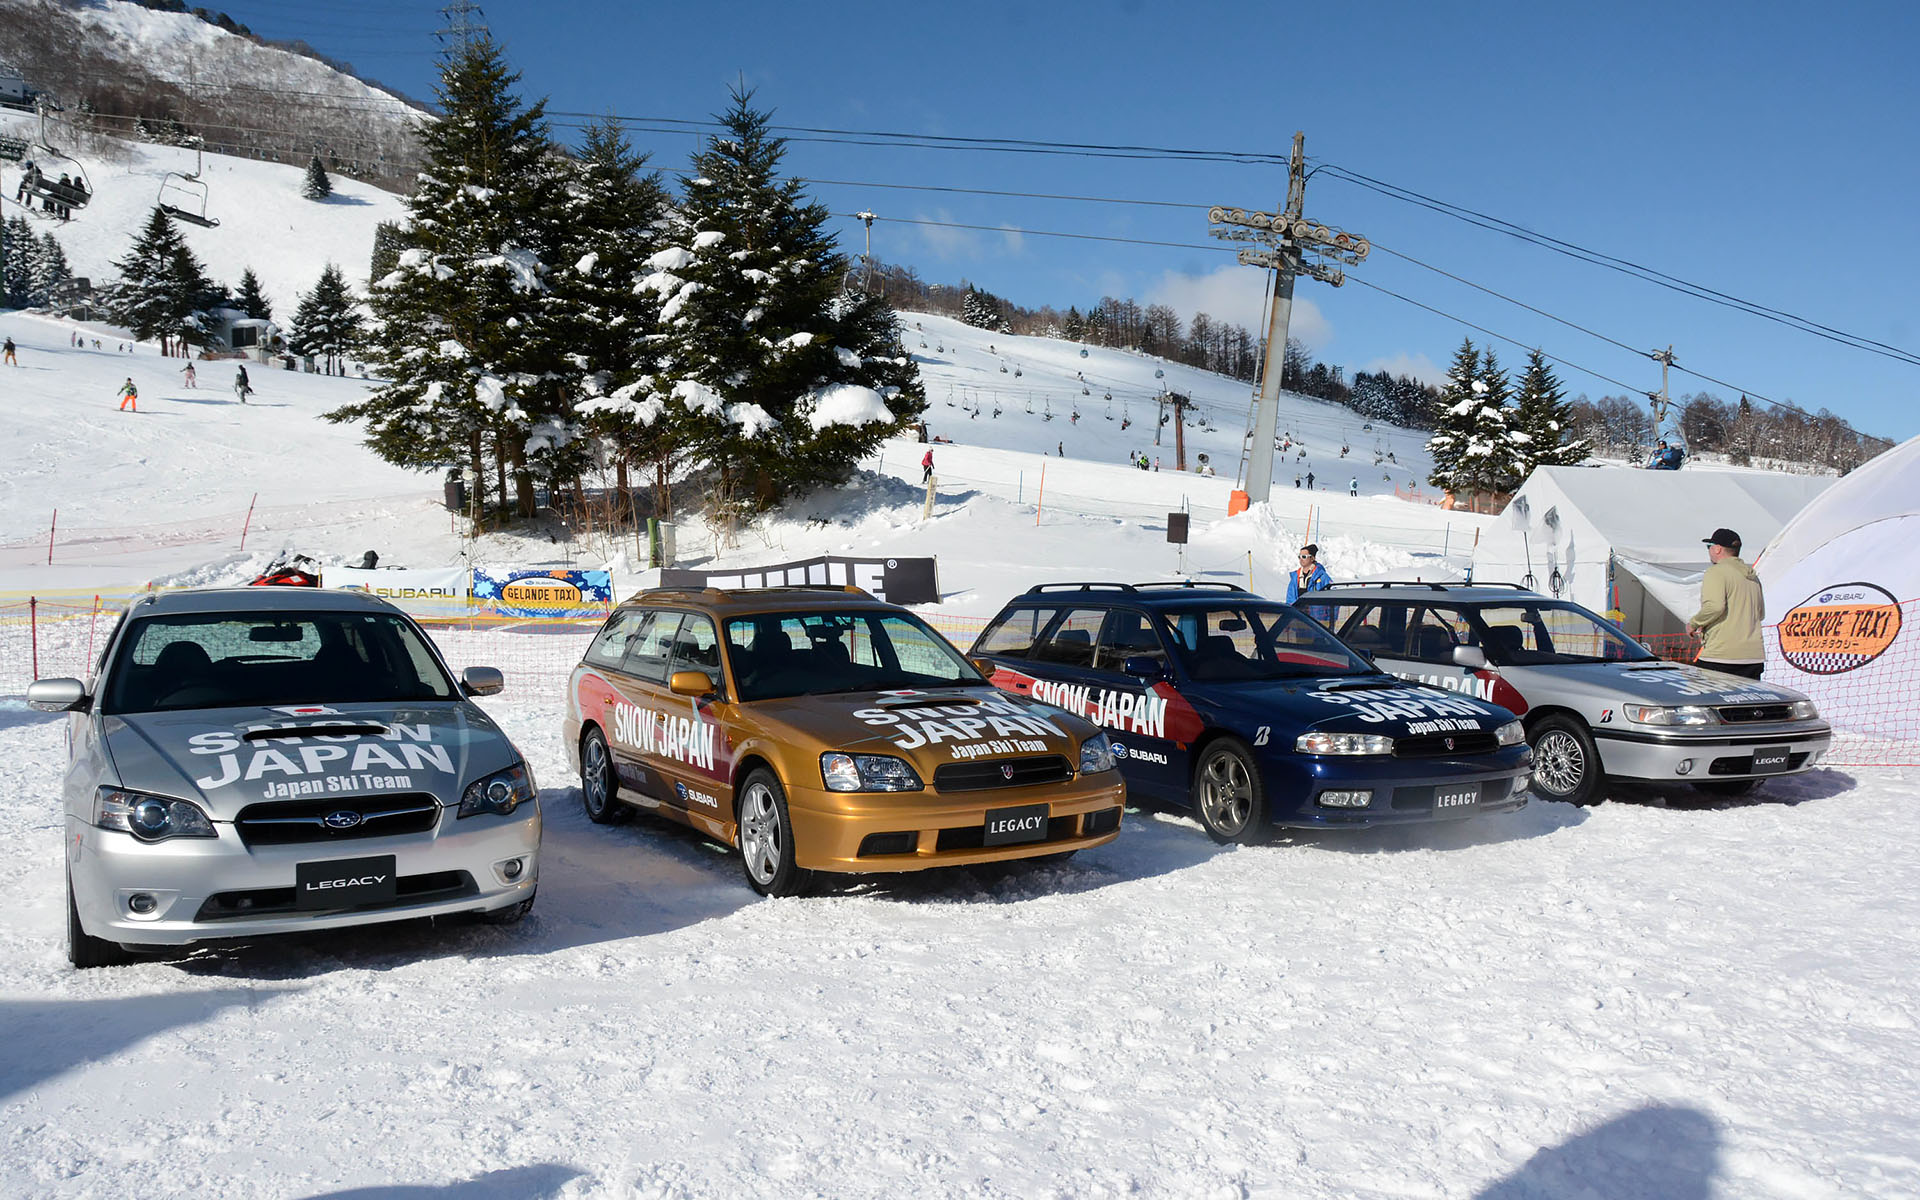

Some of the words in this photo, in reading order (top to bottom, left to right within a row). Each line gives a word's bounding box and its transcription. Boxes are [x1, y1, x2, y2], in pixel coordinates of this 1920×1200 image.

[376, 588, 456, 599] SUBARU
[507, 588, 550, 601] GELANDE
[554, 589, 575, 601] TAXI
[1833, 592, 1866, 601] SUBARU
[1850, 609, 1892, 639] TAXI
[1031, 680, 1091, 718] SNOW
[1091, 688, 1168, 738] JAPAN
[1350, 698, 1492, 723] JAPAN
[893, 715, 1068, 750] JAPAN
[1406, 721, 1439, 735] Japan
[1433, 719, 1457, 731] Ski
[1451, 718, 1481, 730] Team
[614, 702, 657, 752] SNOW
[658, 713, 715, 771] JAPAN
[950, 742, 991, 760] Japan
[991, 740, 1014, 754] Ski
[1010, 739, 1048, 752] Team
[1129, 749, 1168, 765] SUBARU
[196, 743, 456, 790] JAPAN
[1755, 757, 1786, 765] LEGACY
[263, 778, 324, 799] Japan
[327, 775, 359, 793] Ski
[360, 773, 412, 789] Team
[688, 789, 718, 808] SUBARU
[1437, 791, 1478, 808] LEGACY
[990, 816, 1042, 834] LEGACY
[306, 875, 386, 891] LEGACY
